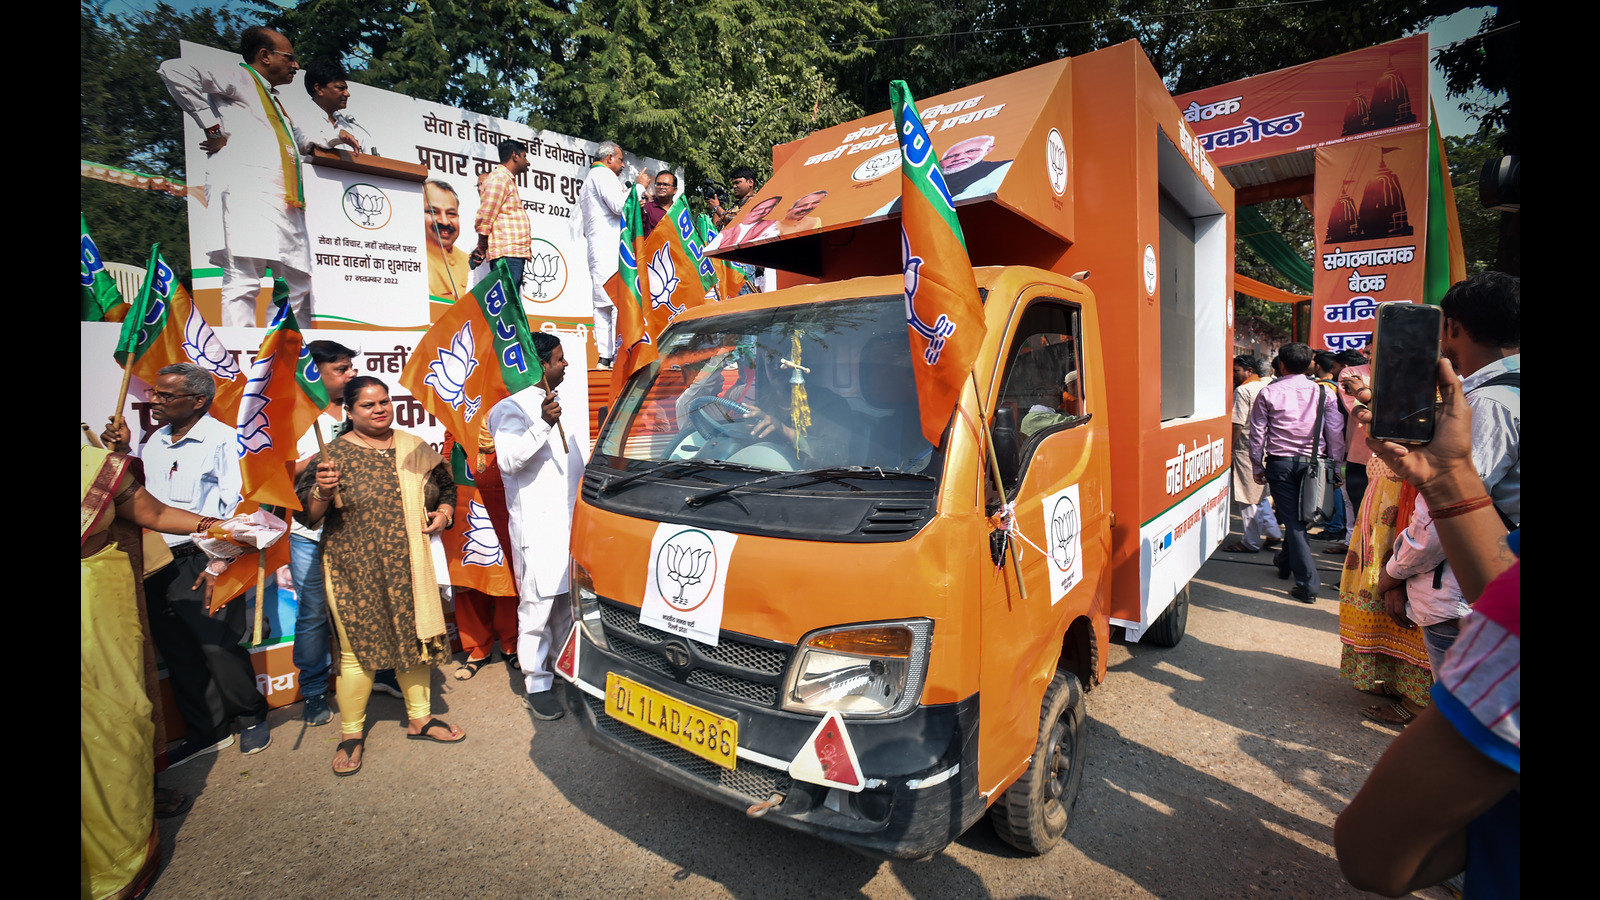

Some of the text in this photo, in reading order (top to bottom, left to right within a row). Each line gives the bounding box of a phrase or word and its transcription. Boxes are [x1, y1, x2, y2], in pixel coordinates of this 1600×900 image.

[1182, 96, 1243, 123] बैठक
[422, 111, 453, 137] सेवा
[456, 119, 471, 141] ही
[543, 143, 586, 167] खोखले
[415, 145, 469, 178] प्रचार
[532, 169, 556, 193] का
[548, 204, 571, 218] 2022
[318, 235, 332, 246] सेवा
[334, 236, 341, 247] ही
[364, 240, 378, 250] नहीं
[402, 244, 417, 254] प्रचार
[315, 252, 421, 274] प्रचार वाहनों का शुभारंभ
[1322, 245, 1416, 271] संगठनात्मक
[344, 274, 353, 282] 07
[384, 277, 398, 285] 2022
[1348, 268, 1387, 293] बैठक
[484, 279, 528, 375] BJP
